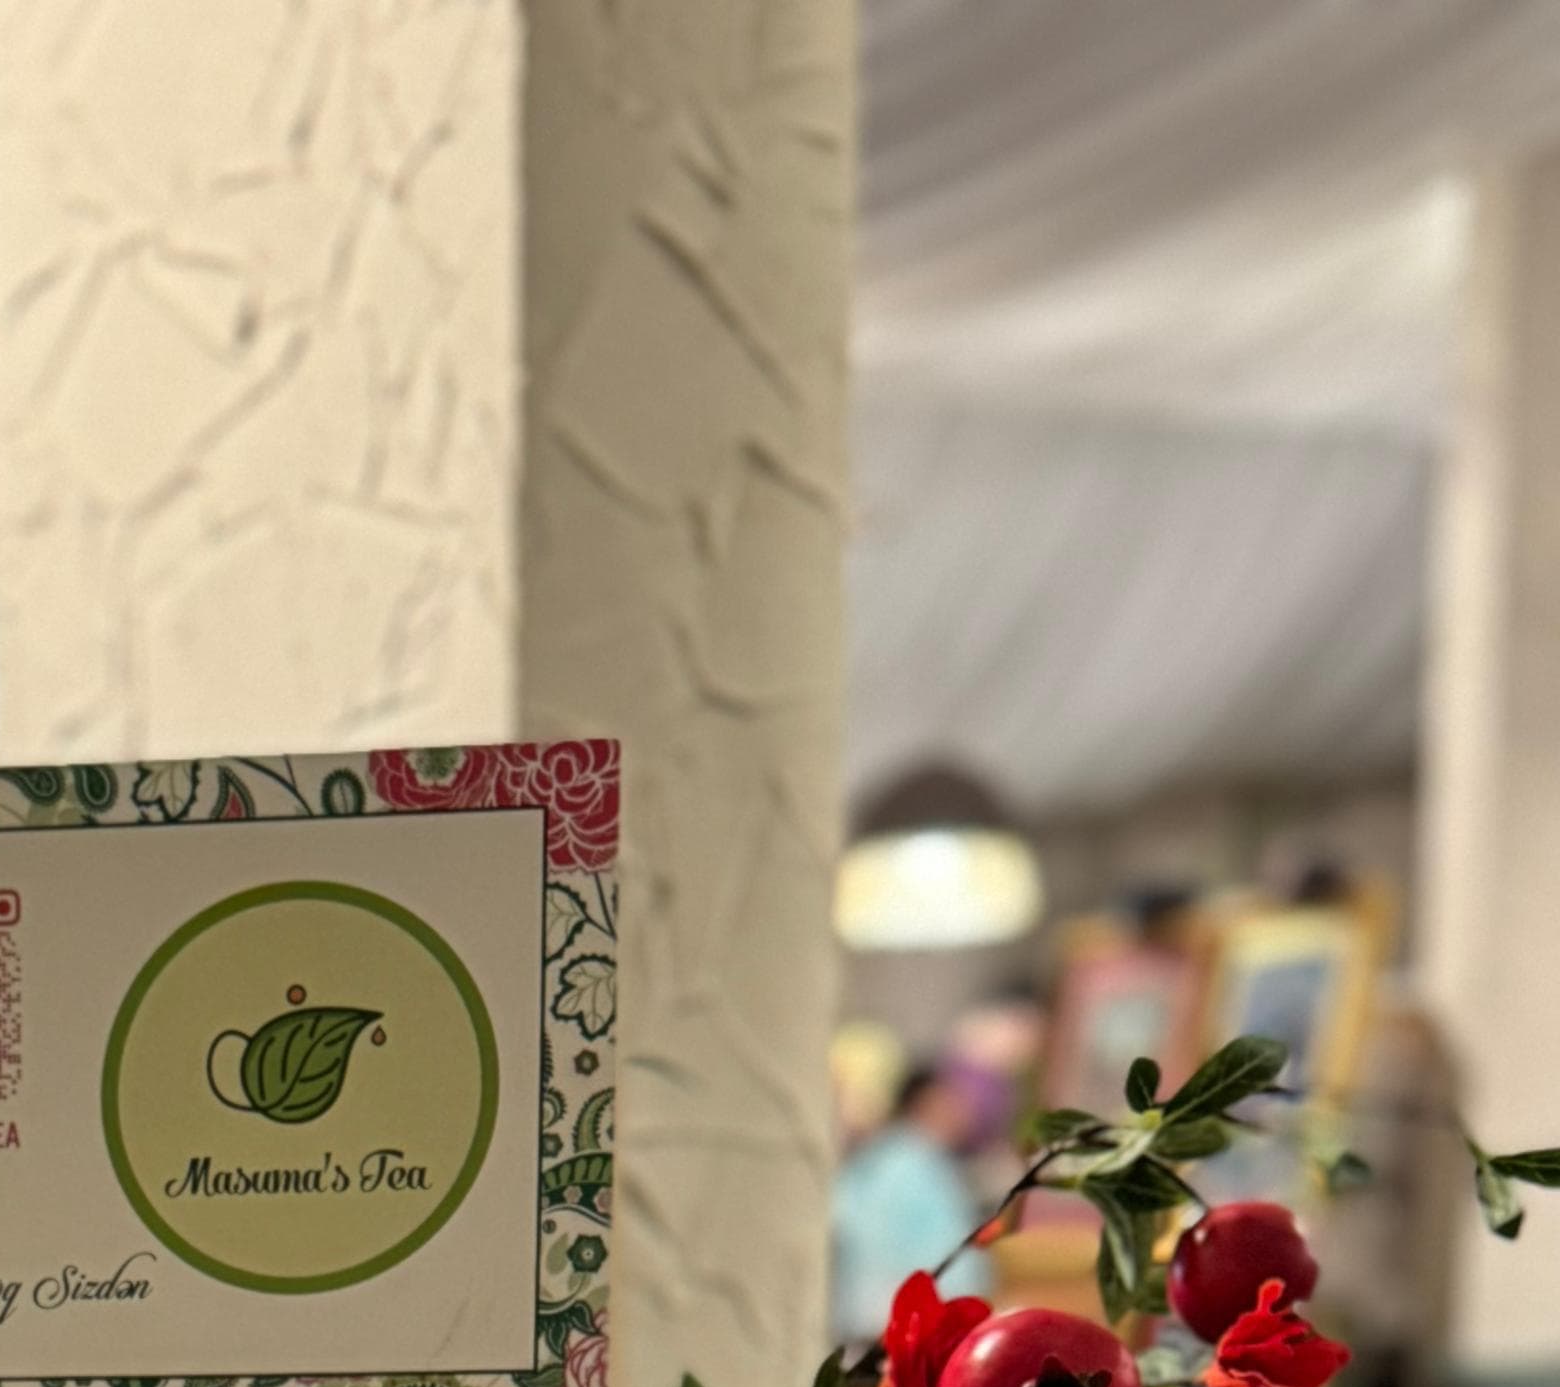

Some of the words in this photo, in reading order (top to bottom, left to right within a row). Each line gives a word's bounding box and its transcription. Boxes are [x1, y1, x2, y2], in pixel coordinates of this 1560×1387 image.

[164, 1152, 350, 1198] Masuma's
[360, 1148, 432, 1193] Tea
[32, 1251, 157, 1309] Sizdən
